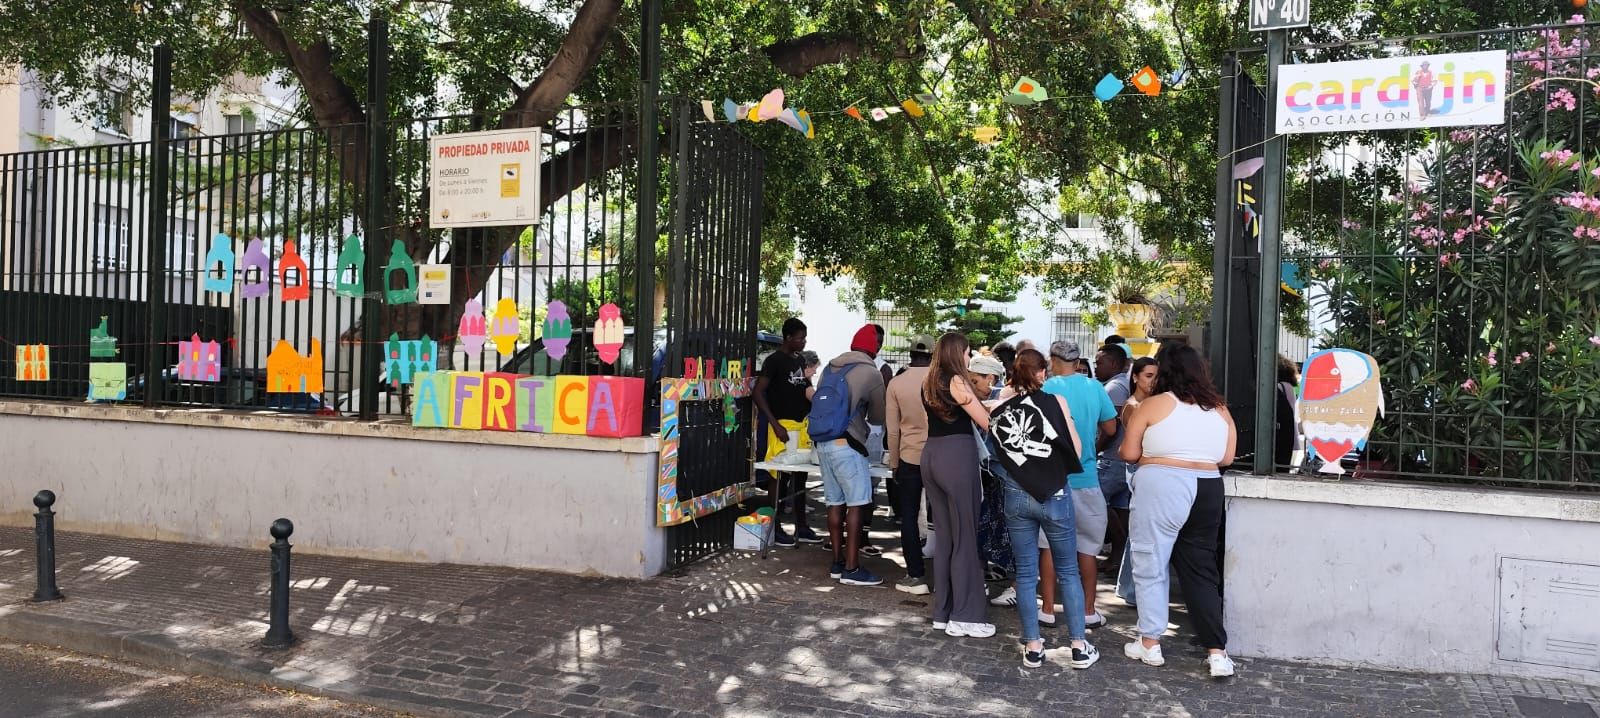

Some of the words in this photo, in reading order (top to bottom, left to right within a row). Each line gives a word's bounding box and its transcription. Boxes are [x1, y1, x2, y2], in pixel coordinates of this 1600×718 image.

[1280, 0, 1305, 23] 40
[1284, 109, 1410, 128] ASOCIACIÓN
[439, 143, 488, 159] PROPIEDAD
[491, 140, 530, 155] PRIVADA
[439, 167, 470, 177] HORARIO
